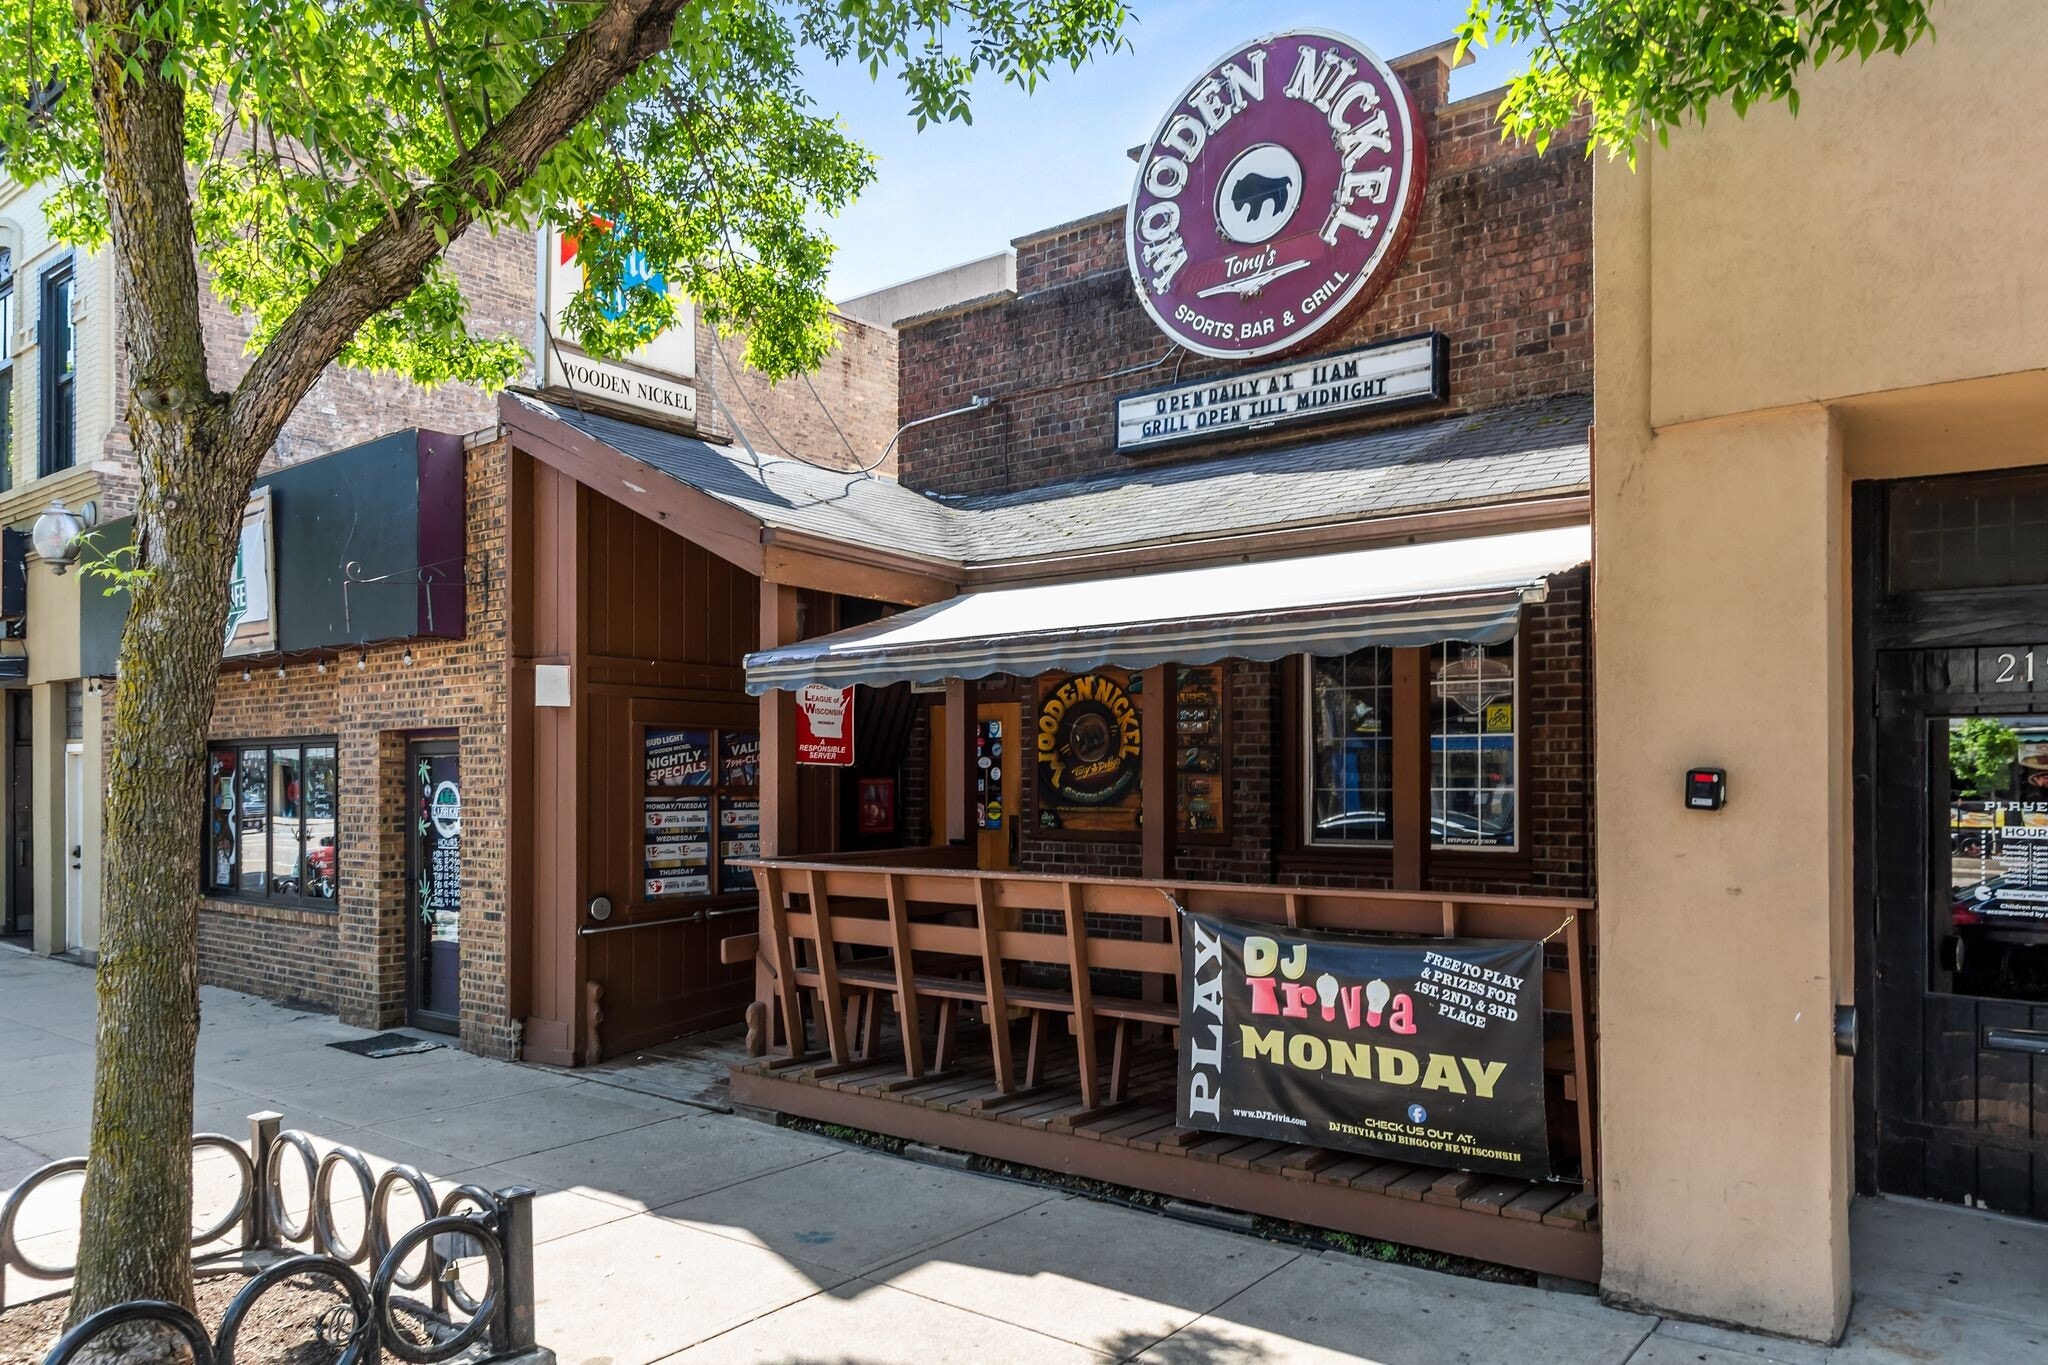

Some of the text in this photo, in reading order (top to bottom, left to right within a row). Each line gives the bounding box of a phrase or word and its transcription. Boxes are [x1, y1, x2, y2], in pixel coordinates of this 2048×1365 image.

[1136, 45, 1392, 295] WOODEN NICKEL
[1224, 245, 1277, 278] Tony's
[1174, 270, 1350, 339] SPORTS BAR & GRILL
[564, 362, 692, 411] WOODEN NICKEL
[1156, 360, 1359, 414] OPEN DAILY AT 11AM
[1141, 377, 1387, 438] GRILL OPEN TILL MIDNIGHT
[1995, 651, 2048, 684] 21
[645, 733, 685, 747] BUD LIGHT
[799, 744, 846, 754] RESPONSIBLE
[809, 751, 837, 760] SERVER
[820, 738, 826, 746] A
[646, 750, 702, 770] NIGHTLY
[649, 761, 707, 781] SPECIALS
[645, 802, 708, 811] MONDAY/TUESDAY
[655, 834, 698, 842] WEDNESDAY
[659, 868, 695, 877] THURSDAY
[2000, 903, 2031, 911] Children
[2034, 911, 2044, 919] by
[1243, 936, 1308, 980] DJ
[1423, 951, 1524, 990] FREE TO PLAY
[1414, 981, 1518, 1022] 1ST, 2ND, & 3RD
[1421, 967, 1517, 1006] & PRIZES FOR
[1245, 972, 1417, 1036] Trivia
[1438, 1003, 1487, 1029] PLACE
[1189, 920, 1224, 1123] PLAY
[1239, 1024, 1507, 1098] MONDAY
[1233, 1108, 1307, 1127] www.DJTrivia.com
[1364, 1118, 1476, 1145] CHECK US OUT AT:
[1328, 1121, 1521, 1162] DJ TRIVIA & DJ BINGO OF NE WISCONSIN
